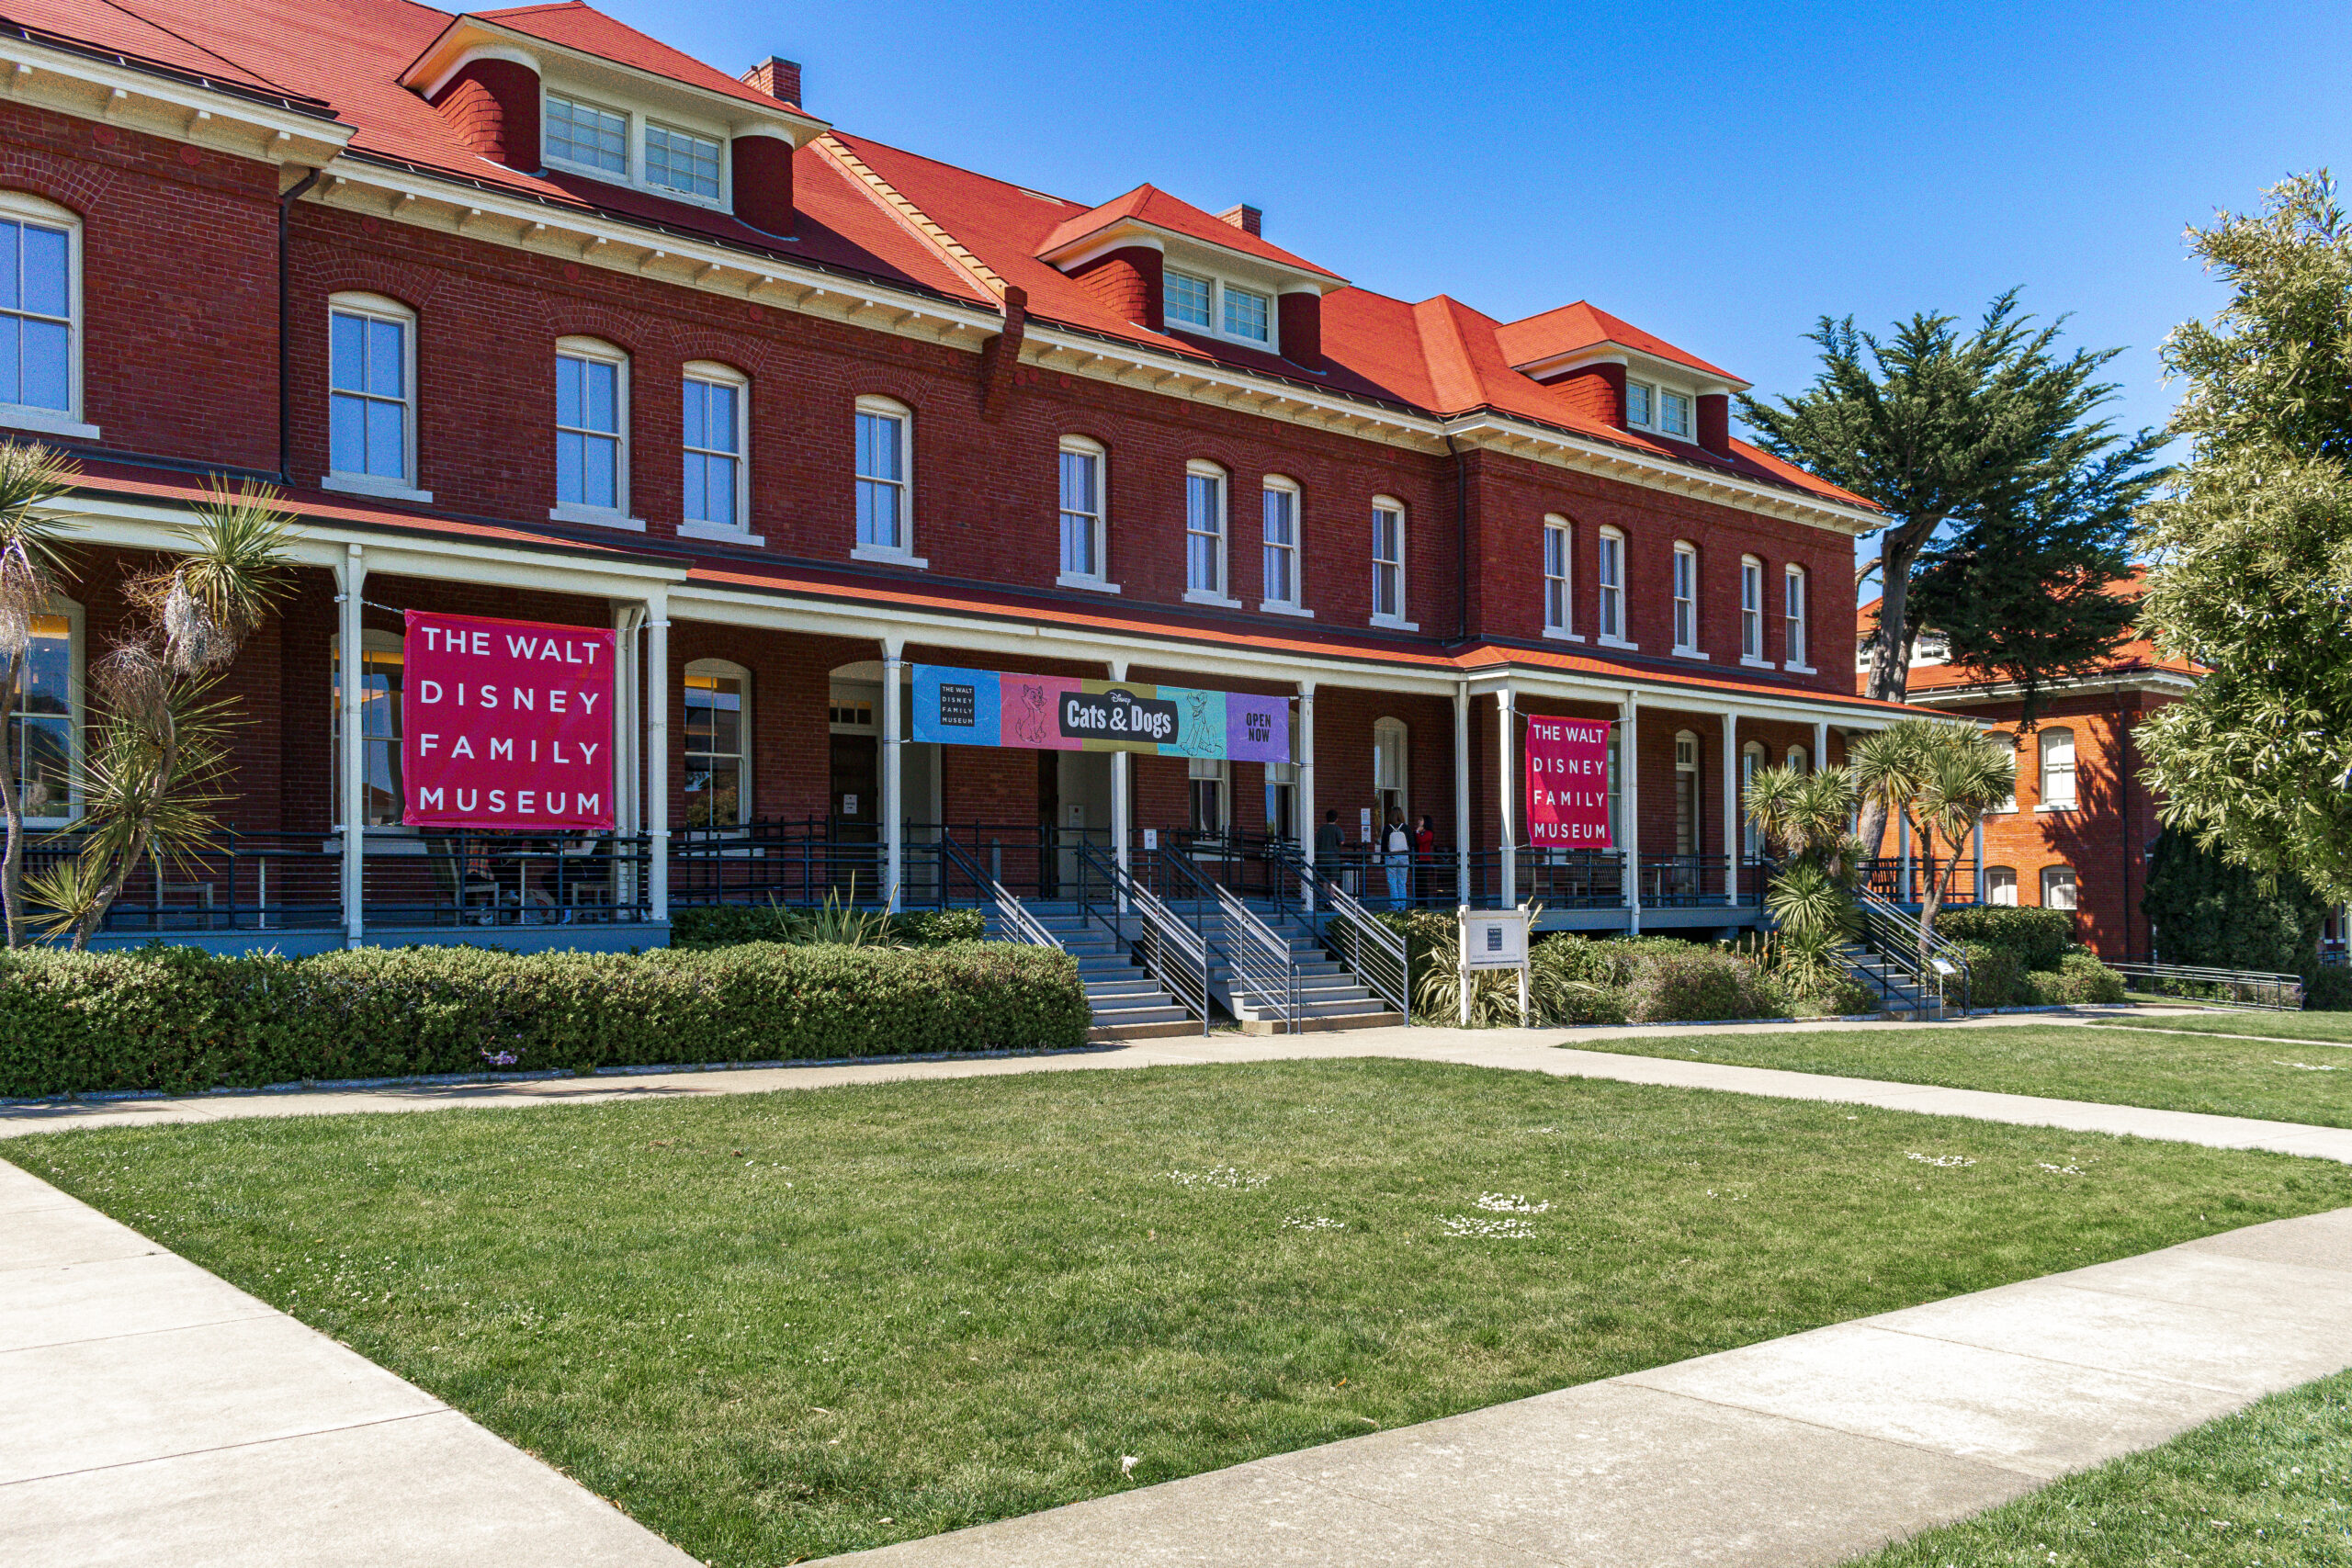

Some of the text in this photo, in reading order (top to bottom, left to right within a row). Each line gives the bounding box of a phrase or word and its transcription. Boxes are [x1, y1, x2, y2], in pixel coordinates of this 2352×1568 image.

[422, 626, 600, 664] THE WALT
[420, 680, 599, 715] DISNEY
[942, 716, 973, 725] MUSEUM
[1067, 699, 1171, 739] Cats & Dogs
[1246, 712, 1272, 728] OPEN
[1249, 727, 1270, 742] NOW
[1533, 725, 1603, 743] THE WALT
[420, 733, 598, 765] FAMILY
[1533, 757, 1603, 774] DISNEY
[419, 786, 599, 816] MUSEUM
[1533, 789, 1604, 807] FAMILY
[1534, 822, 1606, 839] MUSEUM
